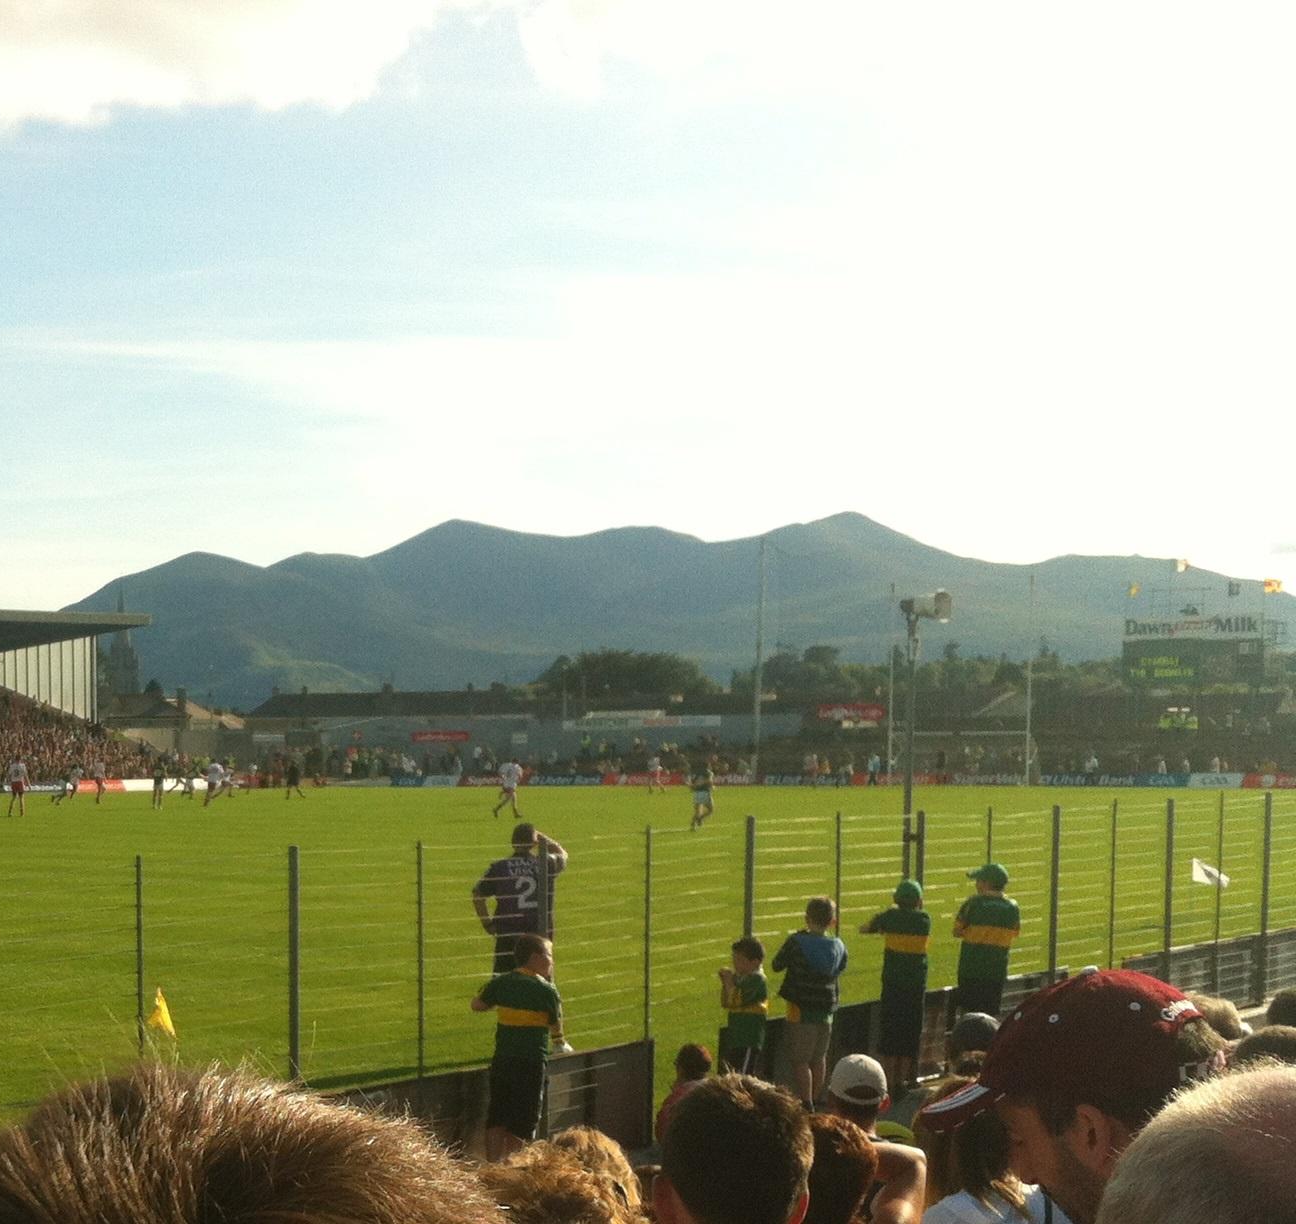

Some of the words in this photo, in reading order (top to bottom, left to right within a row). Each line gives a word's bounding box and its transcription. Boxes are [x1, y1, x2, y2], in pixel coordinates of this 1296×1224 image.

[1125, 619, 1171, 636] Dawn
[1215, 616, 1258, 633] Milk
[515, 876, 538, 909] 2
